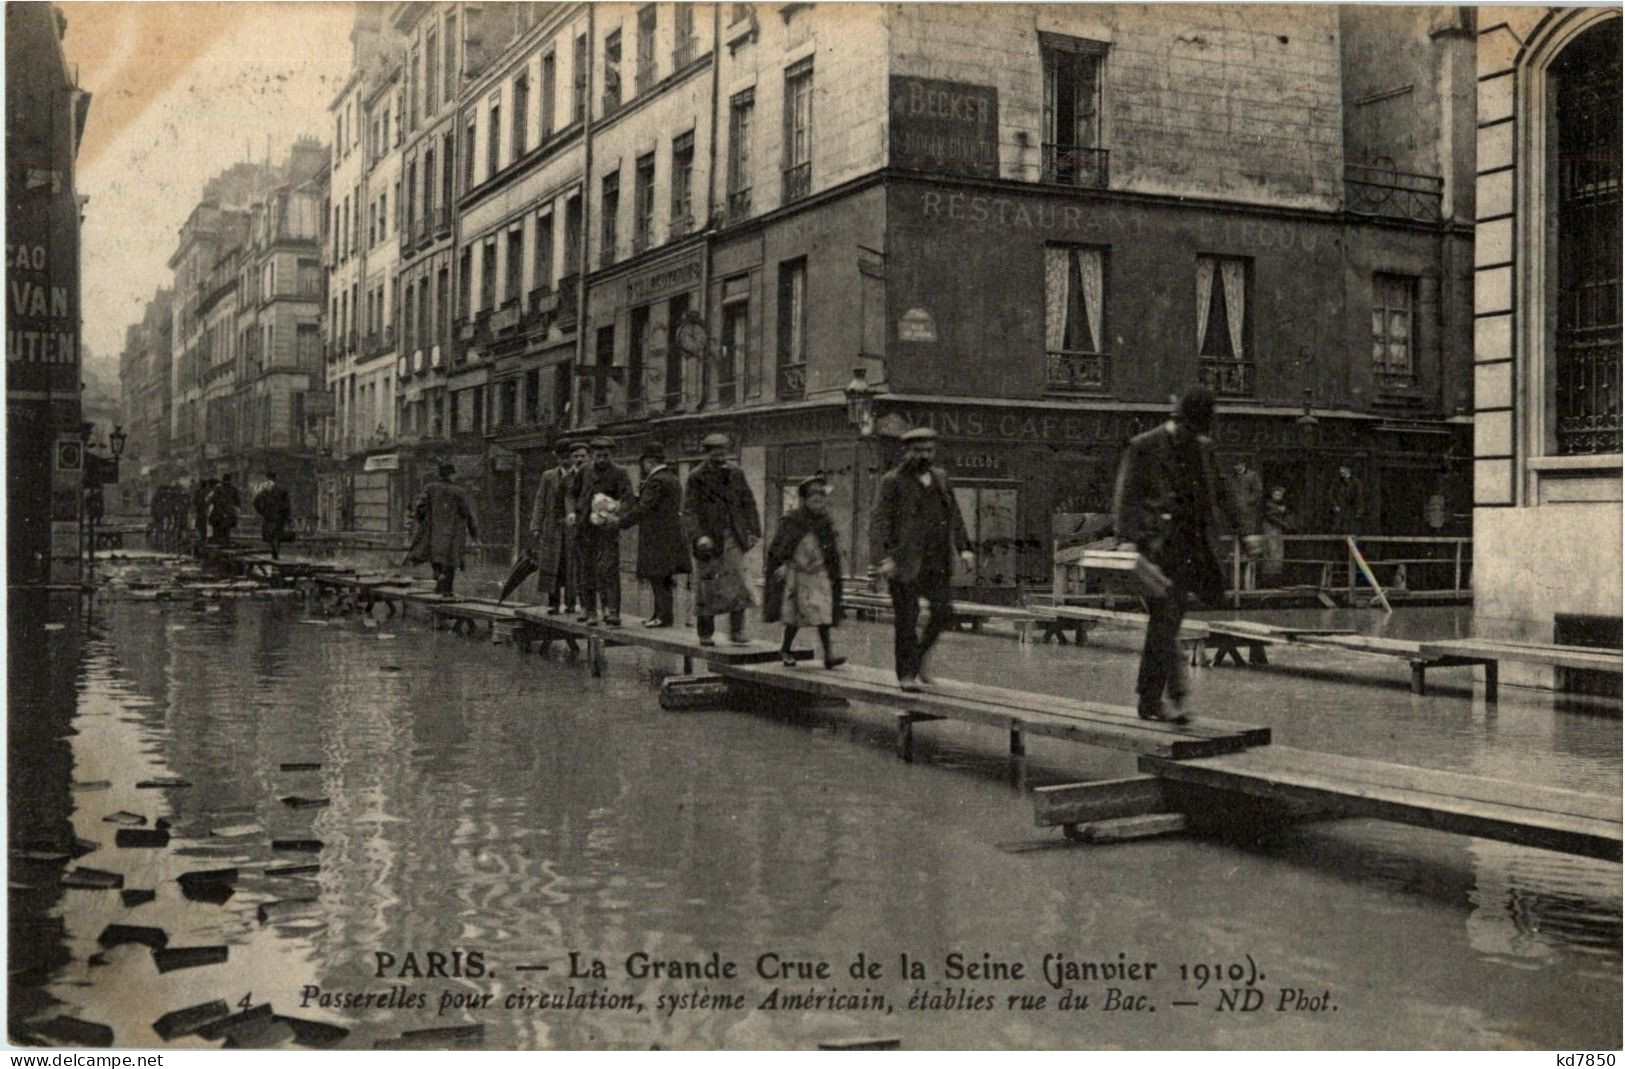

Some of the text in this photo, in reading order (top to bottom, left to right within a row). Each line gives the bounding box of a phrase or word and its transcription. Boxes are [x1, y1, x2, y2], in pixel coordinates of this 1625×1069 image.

[908, 81, 988, 123] BECKER
[922, 191, 1148, 235] RESTAURANT
[11, 280, 67, 317] VAN
[6, 329, 74, 364] UTEN
[905, 411, 983, 436] VINS
